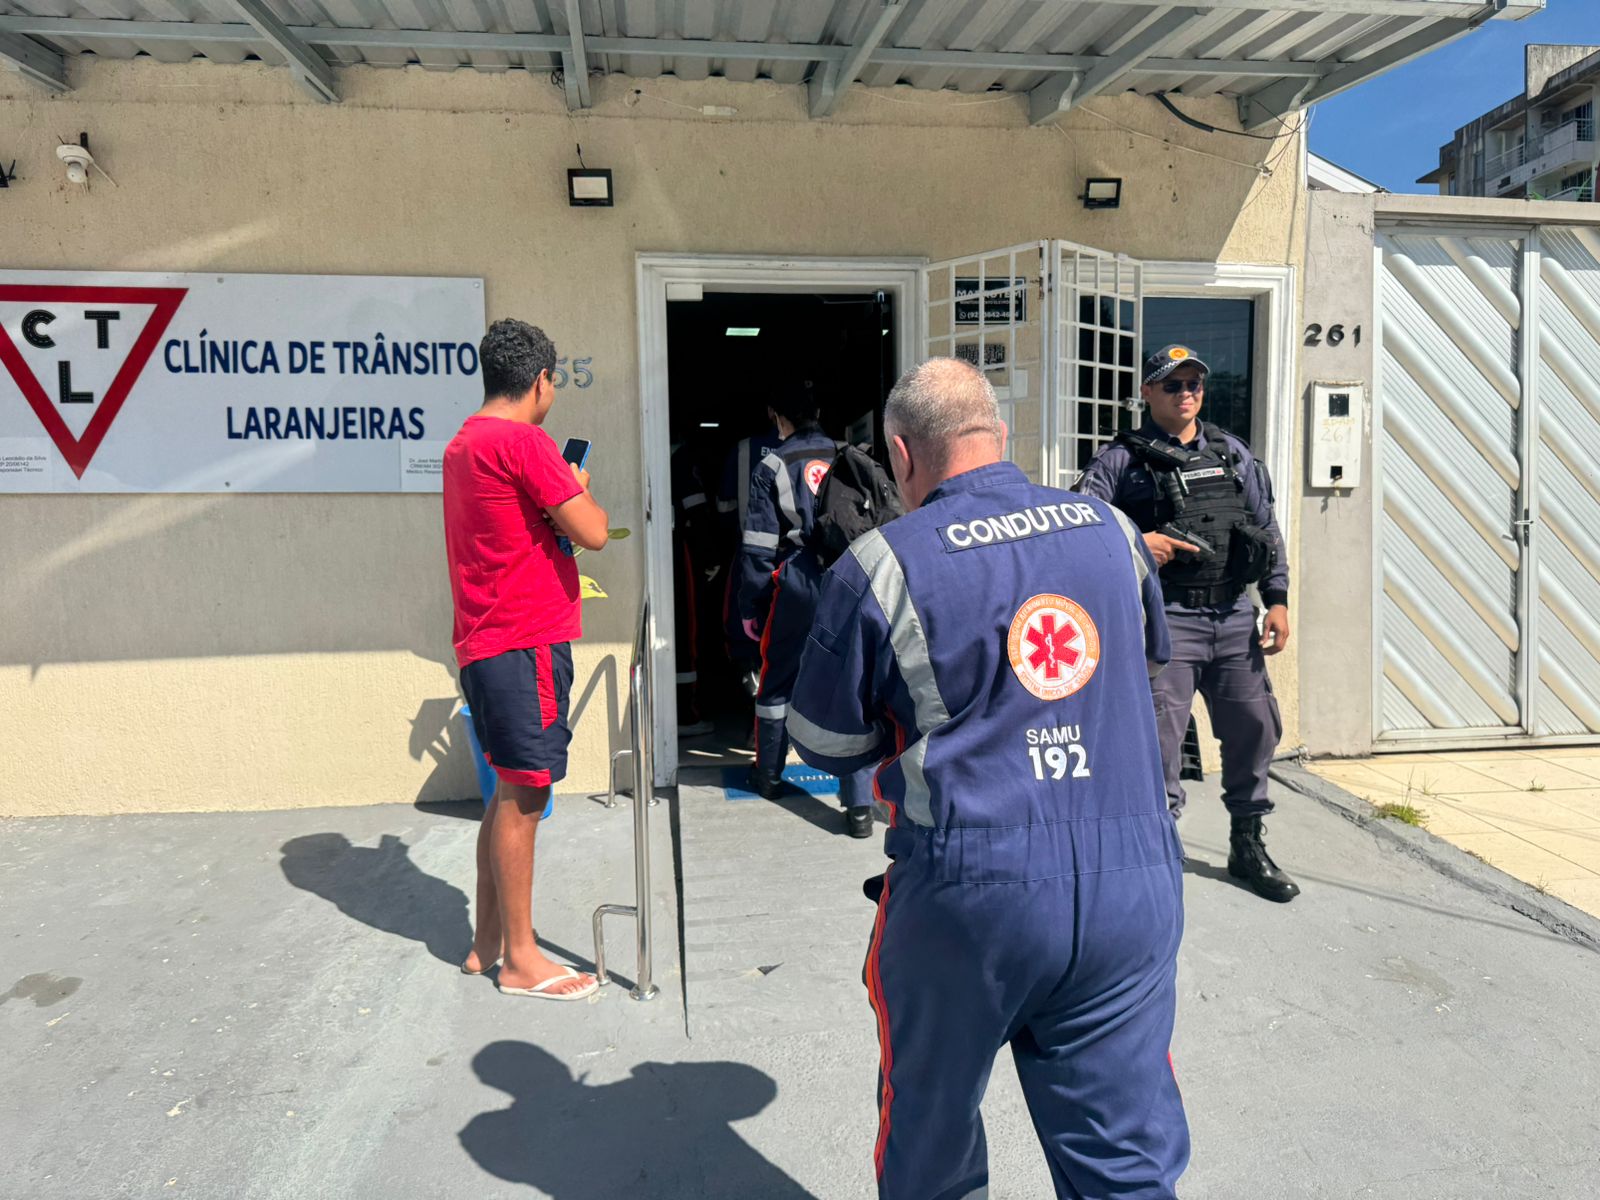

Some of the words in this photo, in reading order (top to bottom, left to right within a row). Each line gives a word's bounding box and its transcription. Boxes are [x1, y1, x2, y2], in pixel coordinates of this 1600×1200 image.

[21, 309, 57, 349] C
[84, 310, 120, 349] T
[1303, 323, 1361, 348] 261
[163, 328, 280, 373] CLÍNICA
[288, 341, 325, 374] DE
[333, 332, 478, 376] TRÂNSITO
[57, 360, 94, 404] L
[226, 406, 425, 440] LARANJEIRAS
[946, 503, 1102, 547] CONDUTOR
[1026, 725, 1080, 745] SAMU
[1029, 744, 1090, 780] 192
